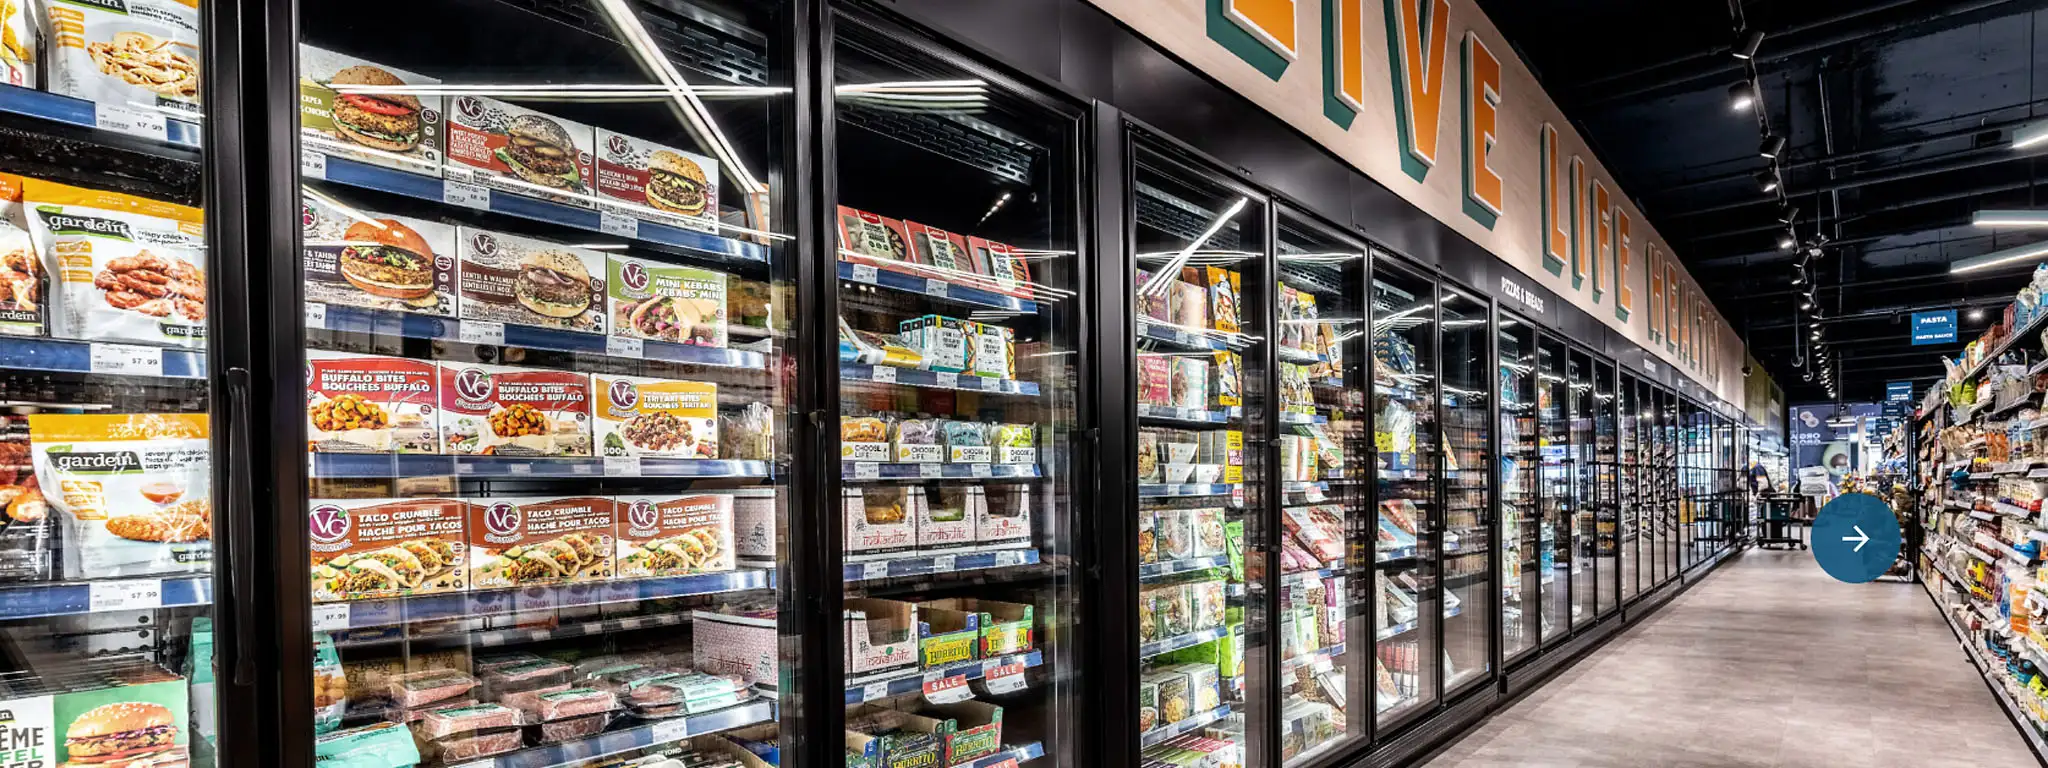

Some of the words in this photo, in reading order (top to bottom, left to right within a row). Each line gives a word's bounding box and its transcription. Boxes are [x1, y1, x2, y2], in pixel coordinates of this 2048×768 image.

[1541, 121, 1633, 322] LIFE
[656, 278, 681, 288] MINI
[683, 280, 722, 291] KEBABS
[656, 287, 695, 298] KEBABS
[700, 290, 722, 299] MINI
[1501, 276, 1520, 301] PIZZAS
[1525, 290, 1545, 314] BREADS
[0, 311, 36, 322] rdein
[1920, 315, 1948, 325] PASTA
[322, 373, 373, 384] BUFFALO
[375, 374, 406, 384] BITES
[383, 383, 430, 393] BUFFALO
[499, 384, 539, 394] BUFFALO
[541, 386, 564, 394] BITES
[546, 393, 584, 402] BUFFALO
[358, 513, 391, 523] TACO
[392, 508, 441, 521] CRUMBLE
[527, 510, 552, 519] TACO
[554, 506, 592, 516] CRUMBLE
[663, 507, 683, 515] TACO
[398, 523, 427, 534] POUR
[429, 520, 463, 531] TACOS
[559, 519, 581, 528] POUR
[584, 517, 610, 525] TACOS
[929, 646, 971, 664] BURRITO
[993, 665, 1017, 678] SALE
[931, 678, 958, 691] SALE
